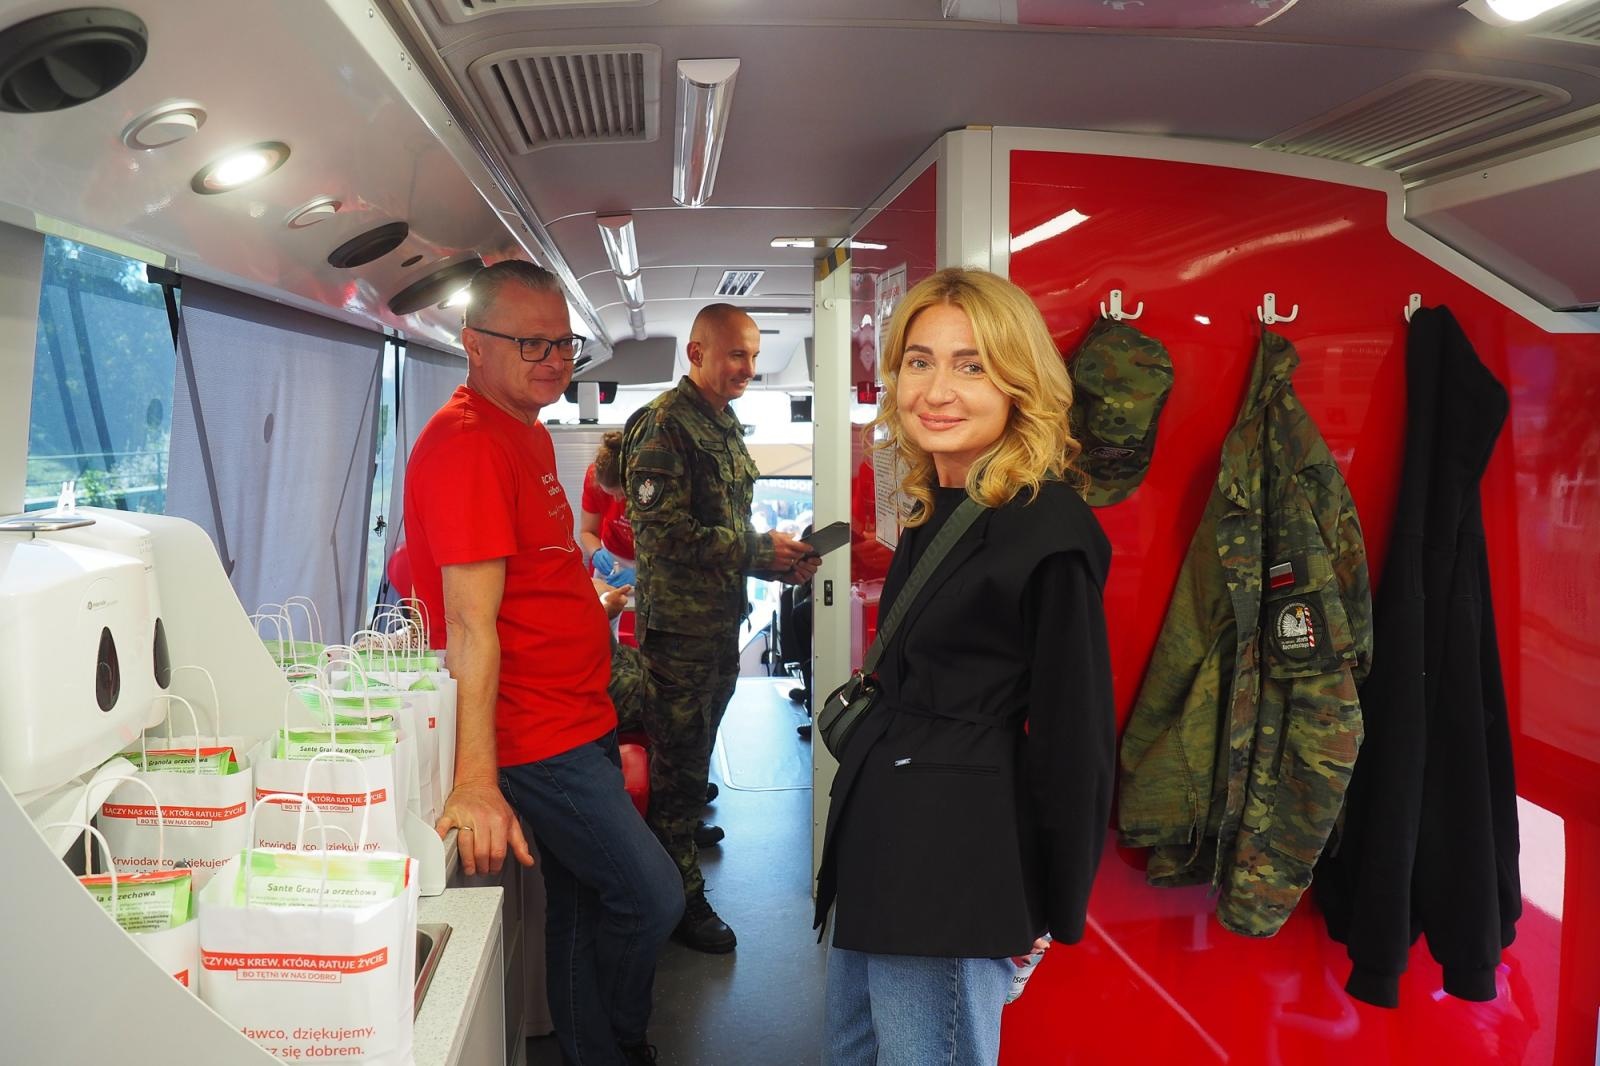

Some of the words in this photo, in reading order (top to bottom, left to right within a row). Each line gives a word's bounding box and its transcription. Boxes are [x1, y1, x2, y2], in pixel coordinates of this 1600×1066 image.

[173, 757, 208, 765] orzechwa
[363, 793, 384, 803] CIE
[169, 807, 195, 817] KTÓRA
[195, 810, 223, 818] RATUJE
[267, 882, 294, 893] Sante
[296, 884, 330, 895] Grana
[332, 887, 377, 896] orzechowa
[107, 890, 156, 901] ozechowa
[203, 956, 223, 967] CZY
[223, 957, 245, 967] NAS
[282, 956, 318, 969] KTÓRA
[319, 959, 355, 970] RATUJE
[357, 952, 385, 969] ŻYCIE
[257, 971, 280, 979] TĘTNI
[280, 971, 290, 979] W
[308, 972, 337, 981] DOBRO
[293, 1026, 376, 1043] dziękujemy.
[282, 1045, 301, 1059] się
[305, 1044, 365, 1057] dobrem.
